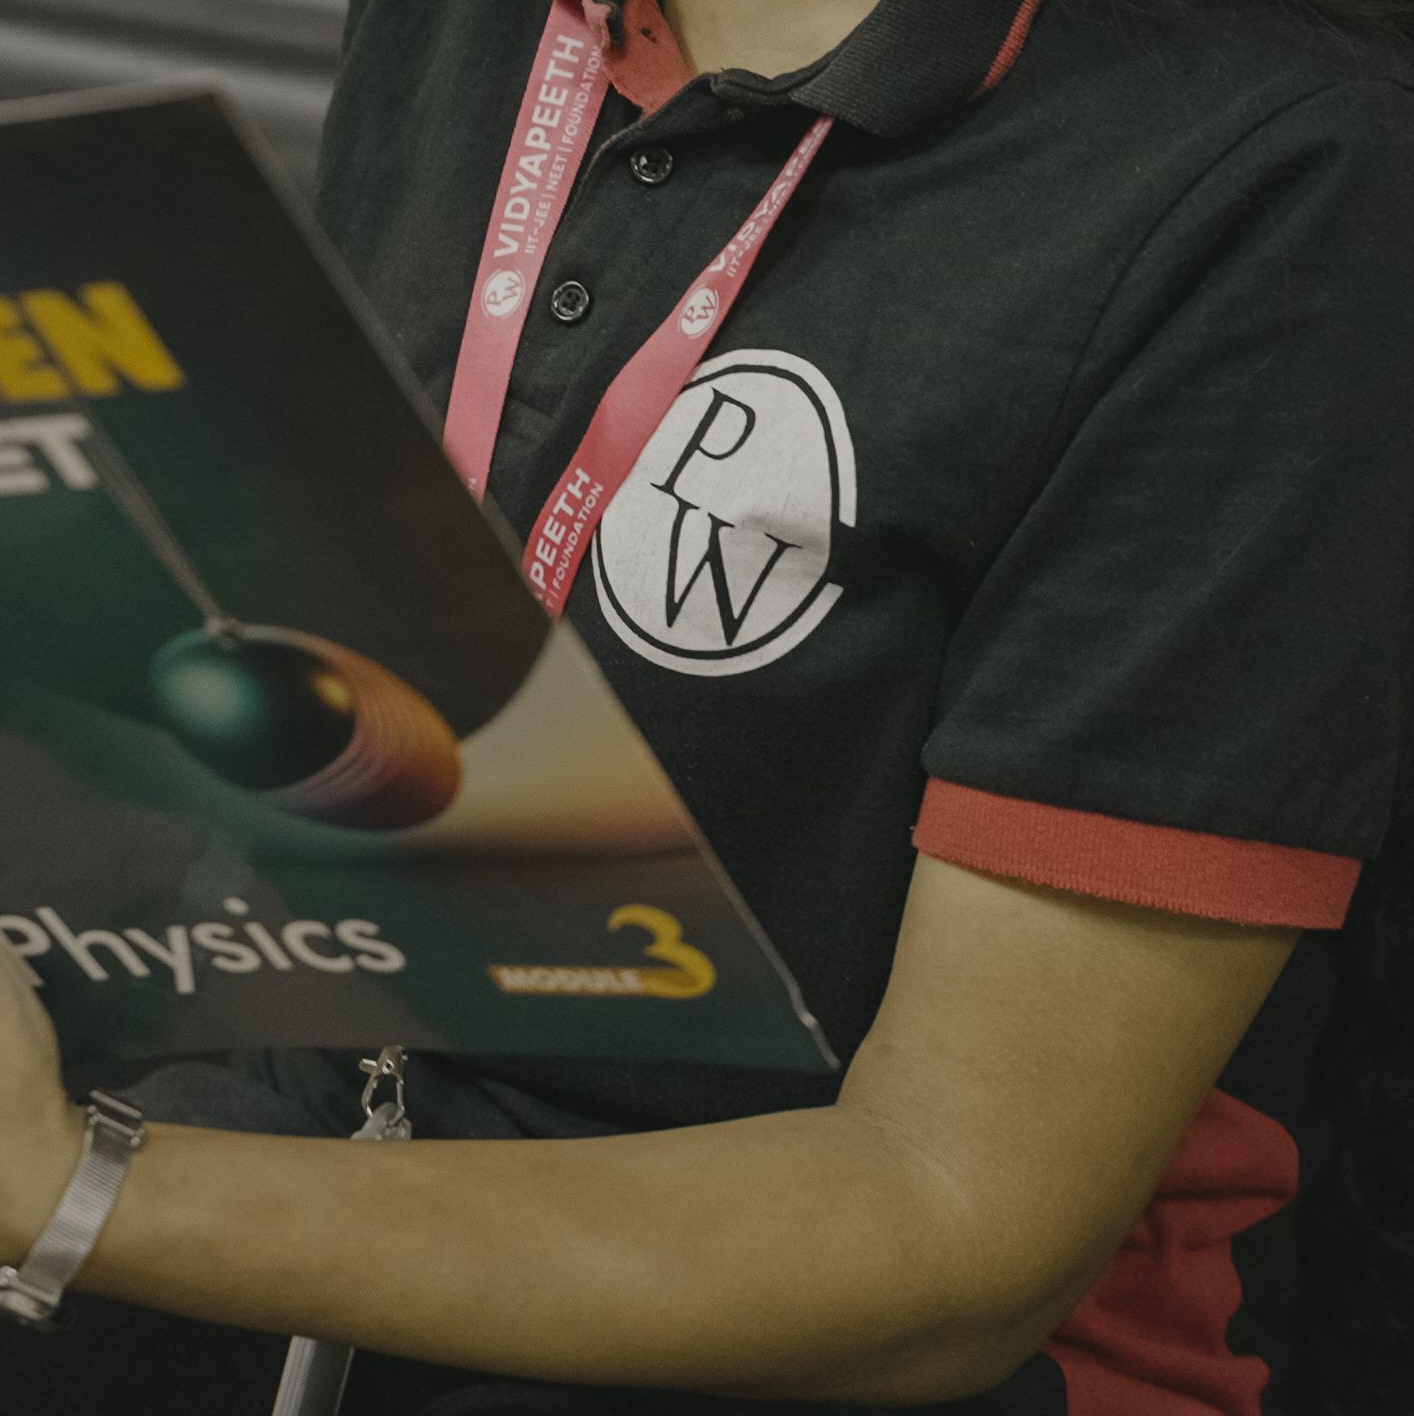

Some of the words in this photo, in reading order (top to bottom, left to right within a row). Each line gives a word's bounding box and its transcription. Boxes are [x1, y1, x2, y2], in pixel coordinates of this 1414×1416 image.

[493, 34, 585, 259] VIDYAPEETH
[524, 202, 551, 255] IIT-JEE
[547, 156, 569, 193] NEET
[528, 467, 592, 602] PEETH
[551, 482, 604, 591] FOUNDATION
[650, 386, 803, 647] PW
[497, 968, 644, 993] MODULE
[606, 904, 716, 999] 3
